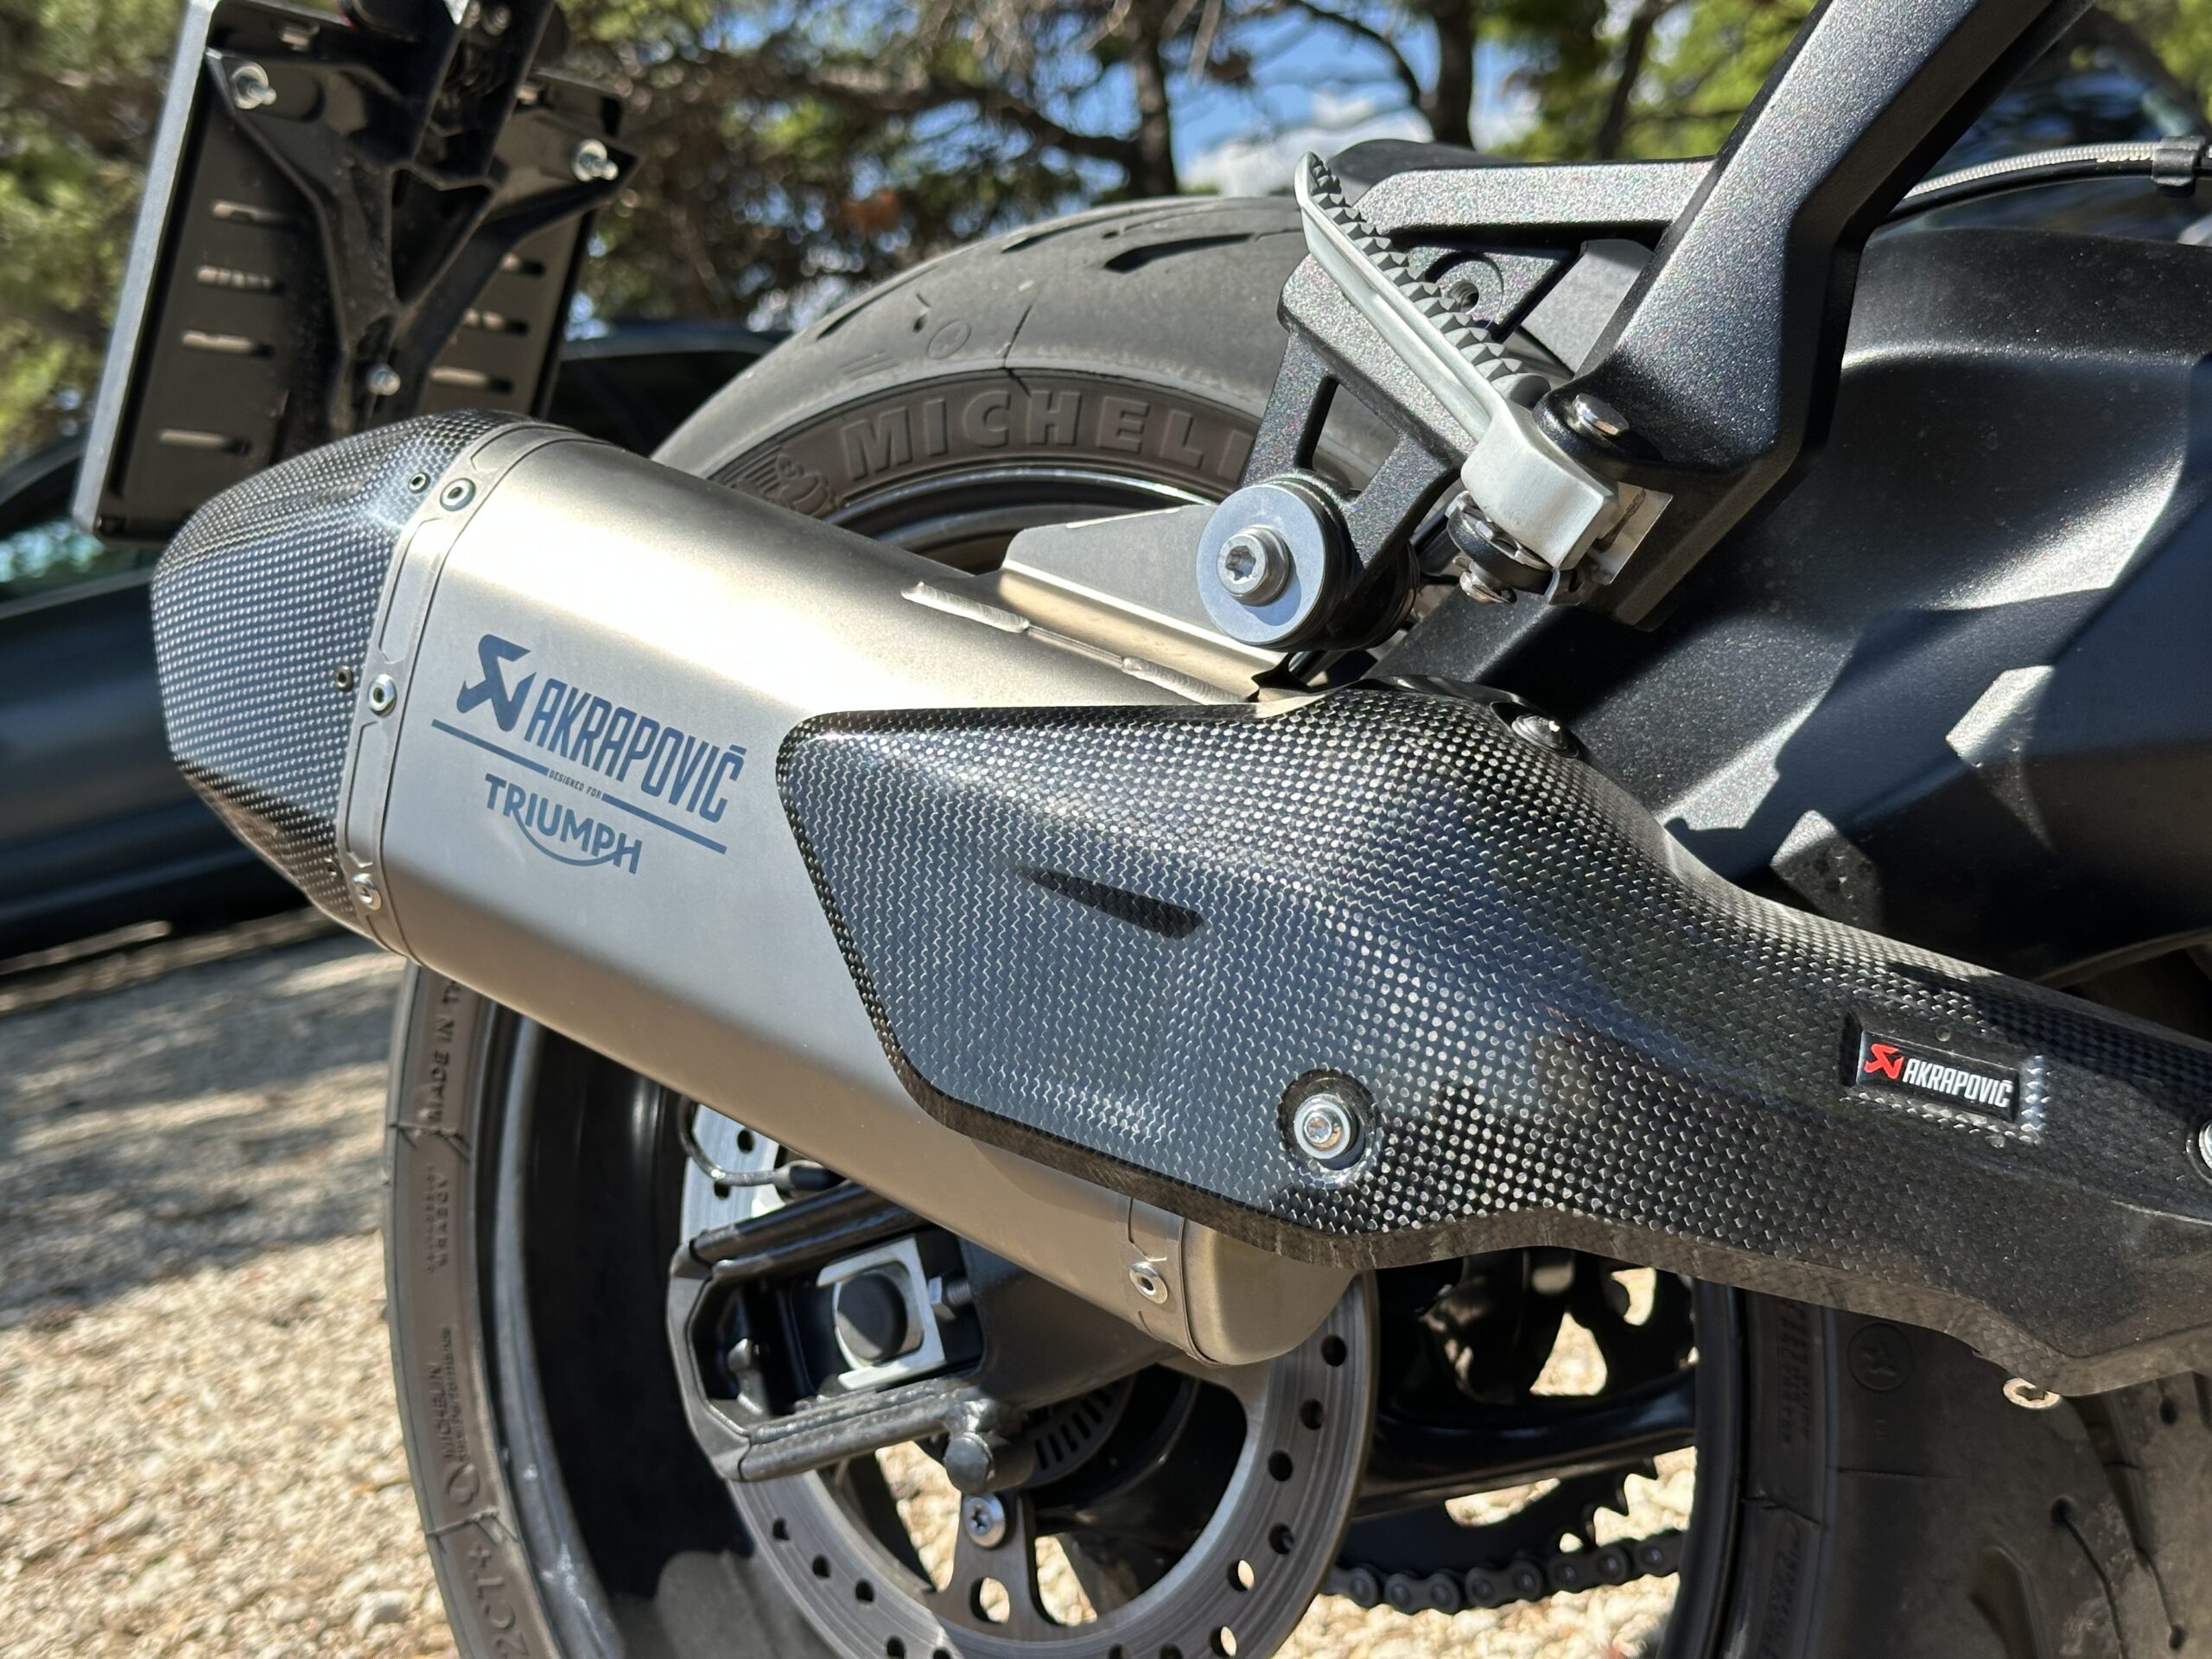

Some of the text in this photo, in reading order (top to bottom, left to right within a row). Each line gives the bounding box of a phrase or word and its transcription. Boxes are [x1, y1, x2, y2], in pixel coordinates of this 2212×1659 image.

[840, 389, 1254, 484] MICHELI
[486, 772, 642, 874] TRIUMPH
[549, 770, 602, 799] DESIGNED FOR
